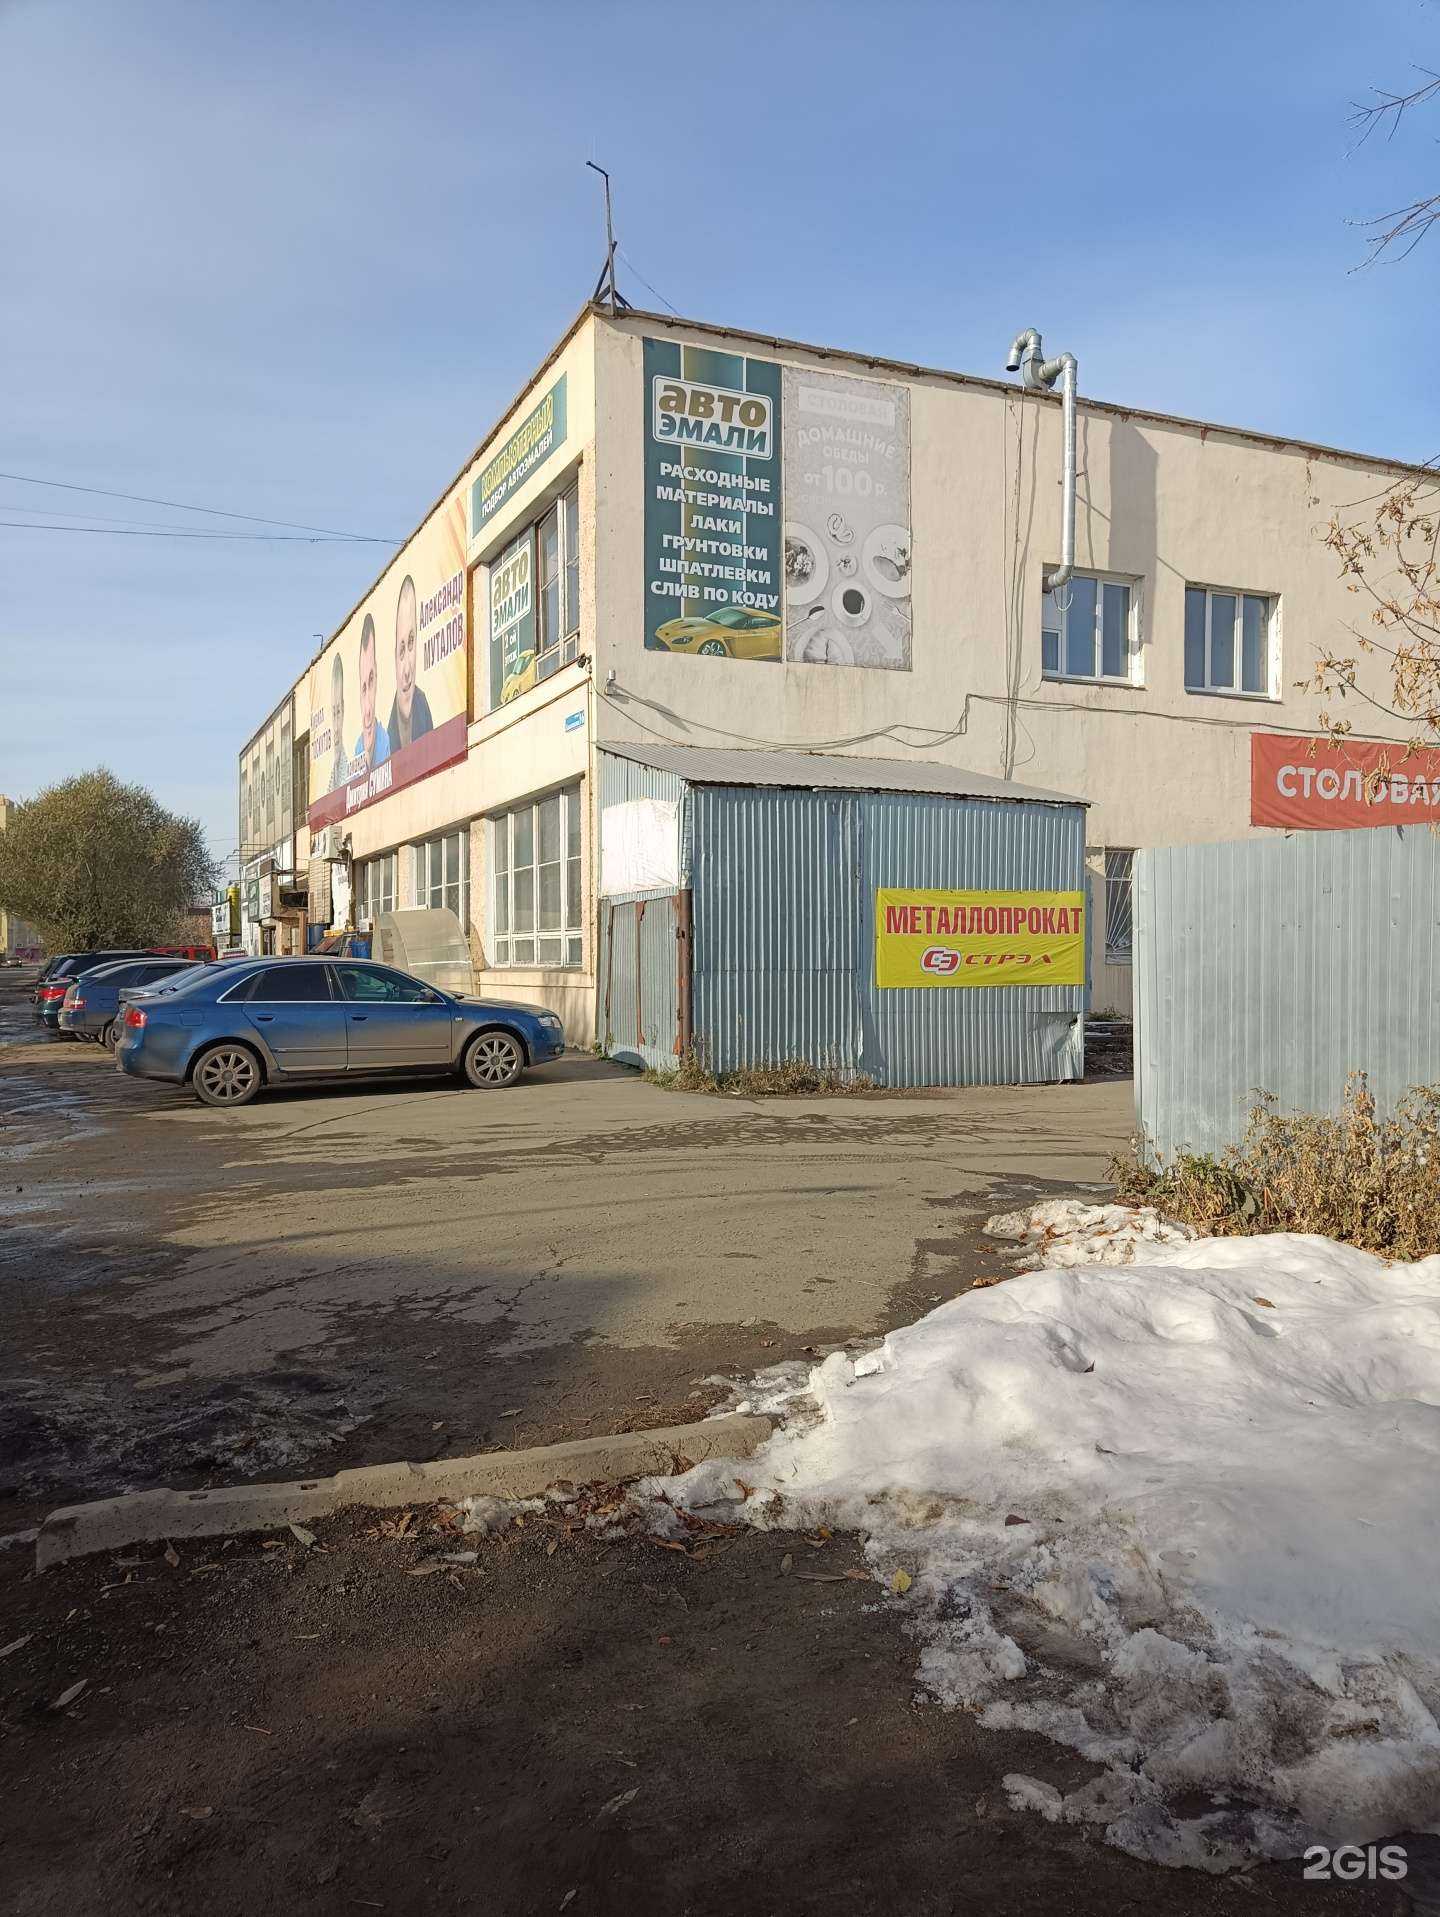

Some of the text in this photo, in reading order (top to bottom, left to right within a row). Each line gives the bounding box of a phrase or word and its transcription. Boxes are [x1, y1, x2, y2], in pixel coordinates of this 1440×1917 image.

[658, 412, 767, 453] ЭМАЛИ
[797, 424, 896, 459] ДОМАШНИЕ
[823, 445, 870, 465] ОБЕДЫ
[482, 427, 553, 519] ПОДБОР АВТОЭМАЛЕЙ
[660, 462, 770, 493] РАСХОДНЫЕ
[821, 464, 873, 497] 100
[656, 485, 774, 516] МАТЕРИАЛЫ
[690, 514, 742, 535] ЛАКИ
[662, 534, 768, 561] ГРУНТОВКИ
[659, 557, 771, 585] ШПАТЛЕВКИ
[419, 571, 463, 631] Александр
[493, 582, 528, 633] ЭМАЛИ
[650, 580, 779, 610] СЛИВ ПО КОДУ
[423, 612, 463, 672] МУТАЛОВ
[886, 905, 1083, 935] МЕТАЛЛОПРОКАТ
